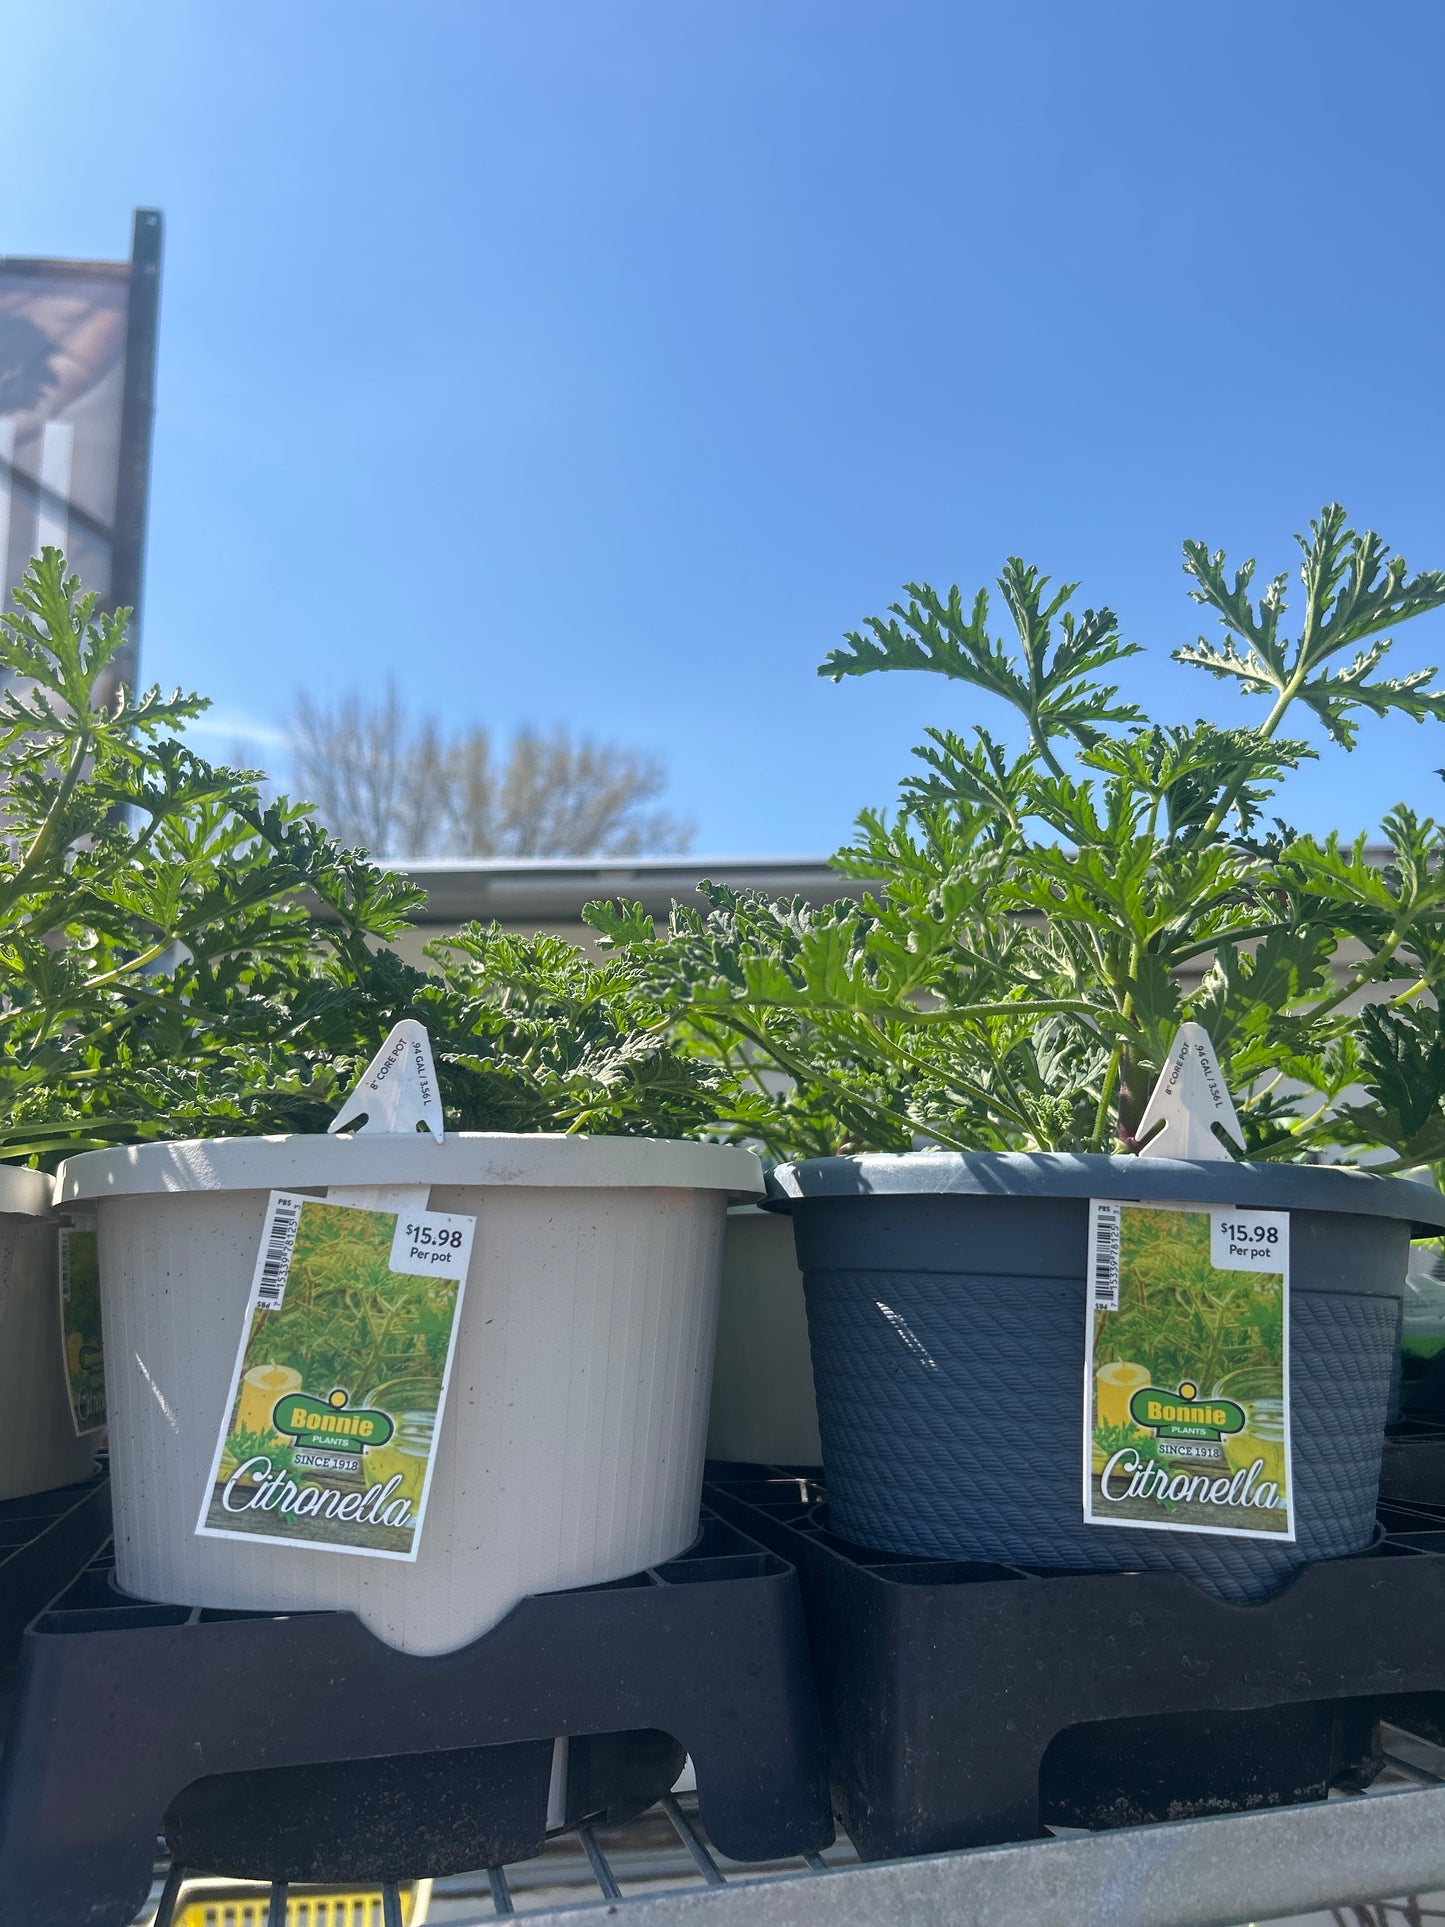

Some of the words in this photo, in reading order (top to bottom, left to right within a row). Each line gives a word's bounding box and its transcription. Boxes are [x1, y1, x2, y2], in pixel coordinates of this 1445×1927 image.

[377, 1055, 396, 1080] CORE
[391, 1038, 407, 1057] POT
[1169, 1061, 1183, 1085] CORE
[1179, 1041, 1190, 1061] POT
[415, 1055, 425, 1074] GAL
[420, 1081, 431, 1099] 3.56
[1199, 1059, 1213, 1077] GAL
[1208, 1082, 1221, 1102] 3.56
[278, 1198, 292, 1207] PBS
[405, 1224, 463, 1248] $15.98
[1110, 1225, 1119, 1256] 78125
[1221, 1222, 1279, 1244] $15.98
[276, 1256, 290, 1288] 15339
[284, 1220, 298, 1252] 78125
[410, 1247, 430, 1261] Per
[431, 1250, 453, 1263] pot
[1229, 1244, 1248, 1256] Per
[1250, 1246, 1271, 1260] pot
[1109, 1260, 1118, 1290] 15339
[290, 1407, 374, 1437] Bonnie
[1147, 1401, 1227, 1426] Bonnie
[312, 1435, 350, 1447] PLANTS
[1171, 1426, 1207, 1436] PLANTS
[293, 1454, 331, 1468] SINCE
[332, 1458, 359, 1472] 1918
[1158, 1444, 1192, 1456] SINCE
[1195, 1446, 1220, 1458] 1918
[222, 1456, 413, 1528] Citronella
[1101, 1448, 1280, 1509] Citronella
